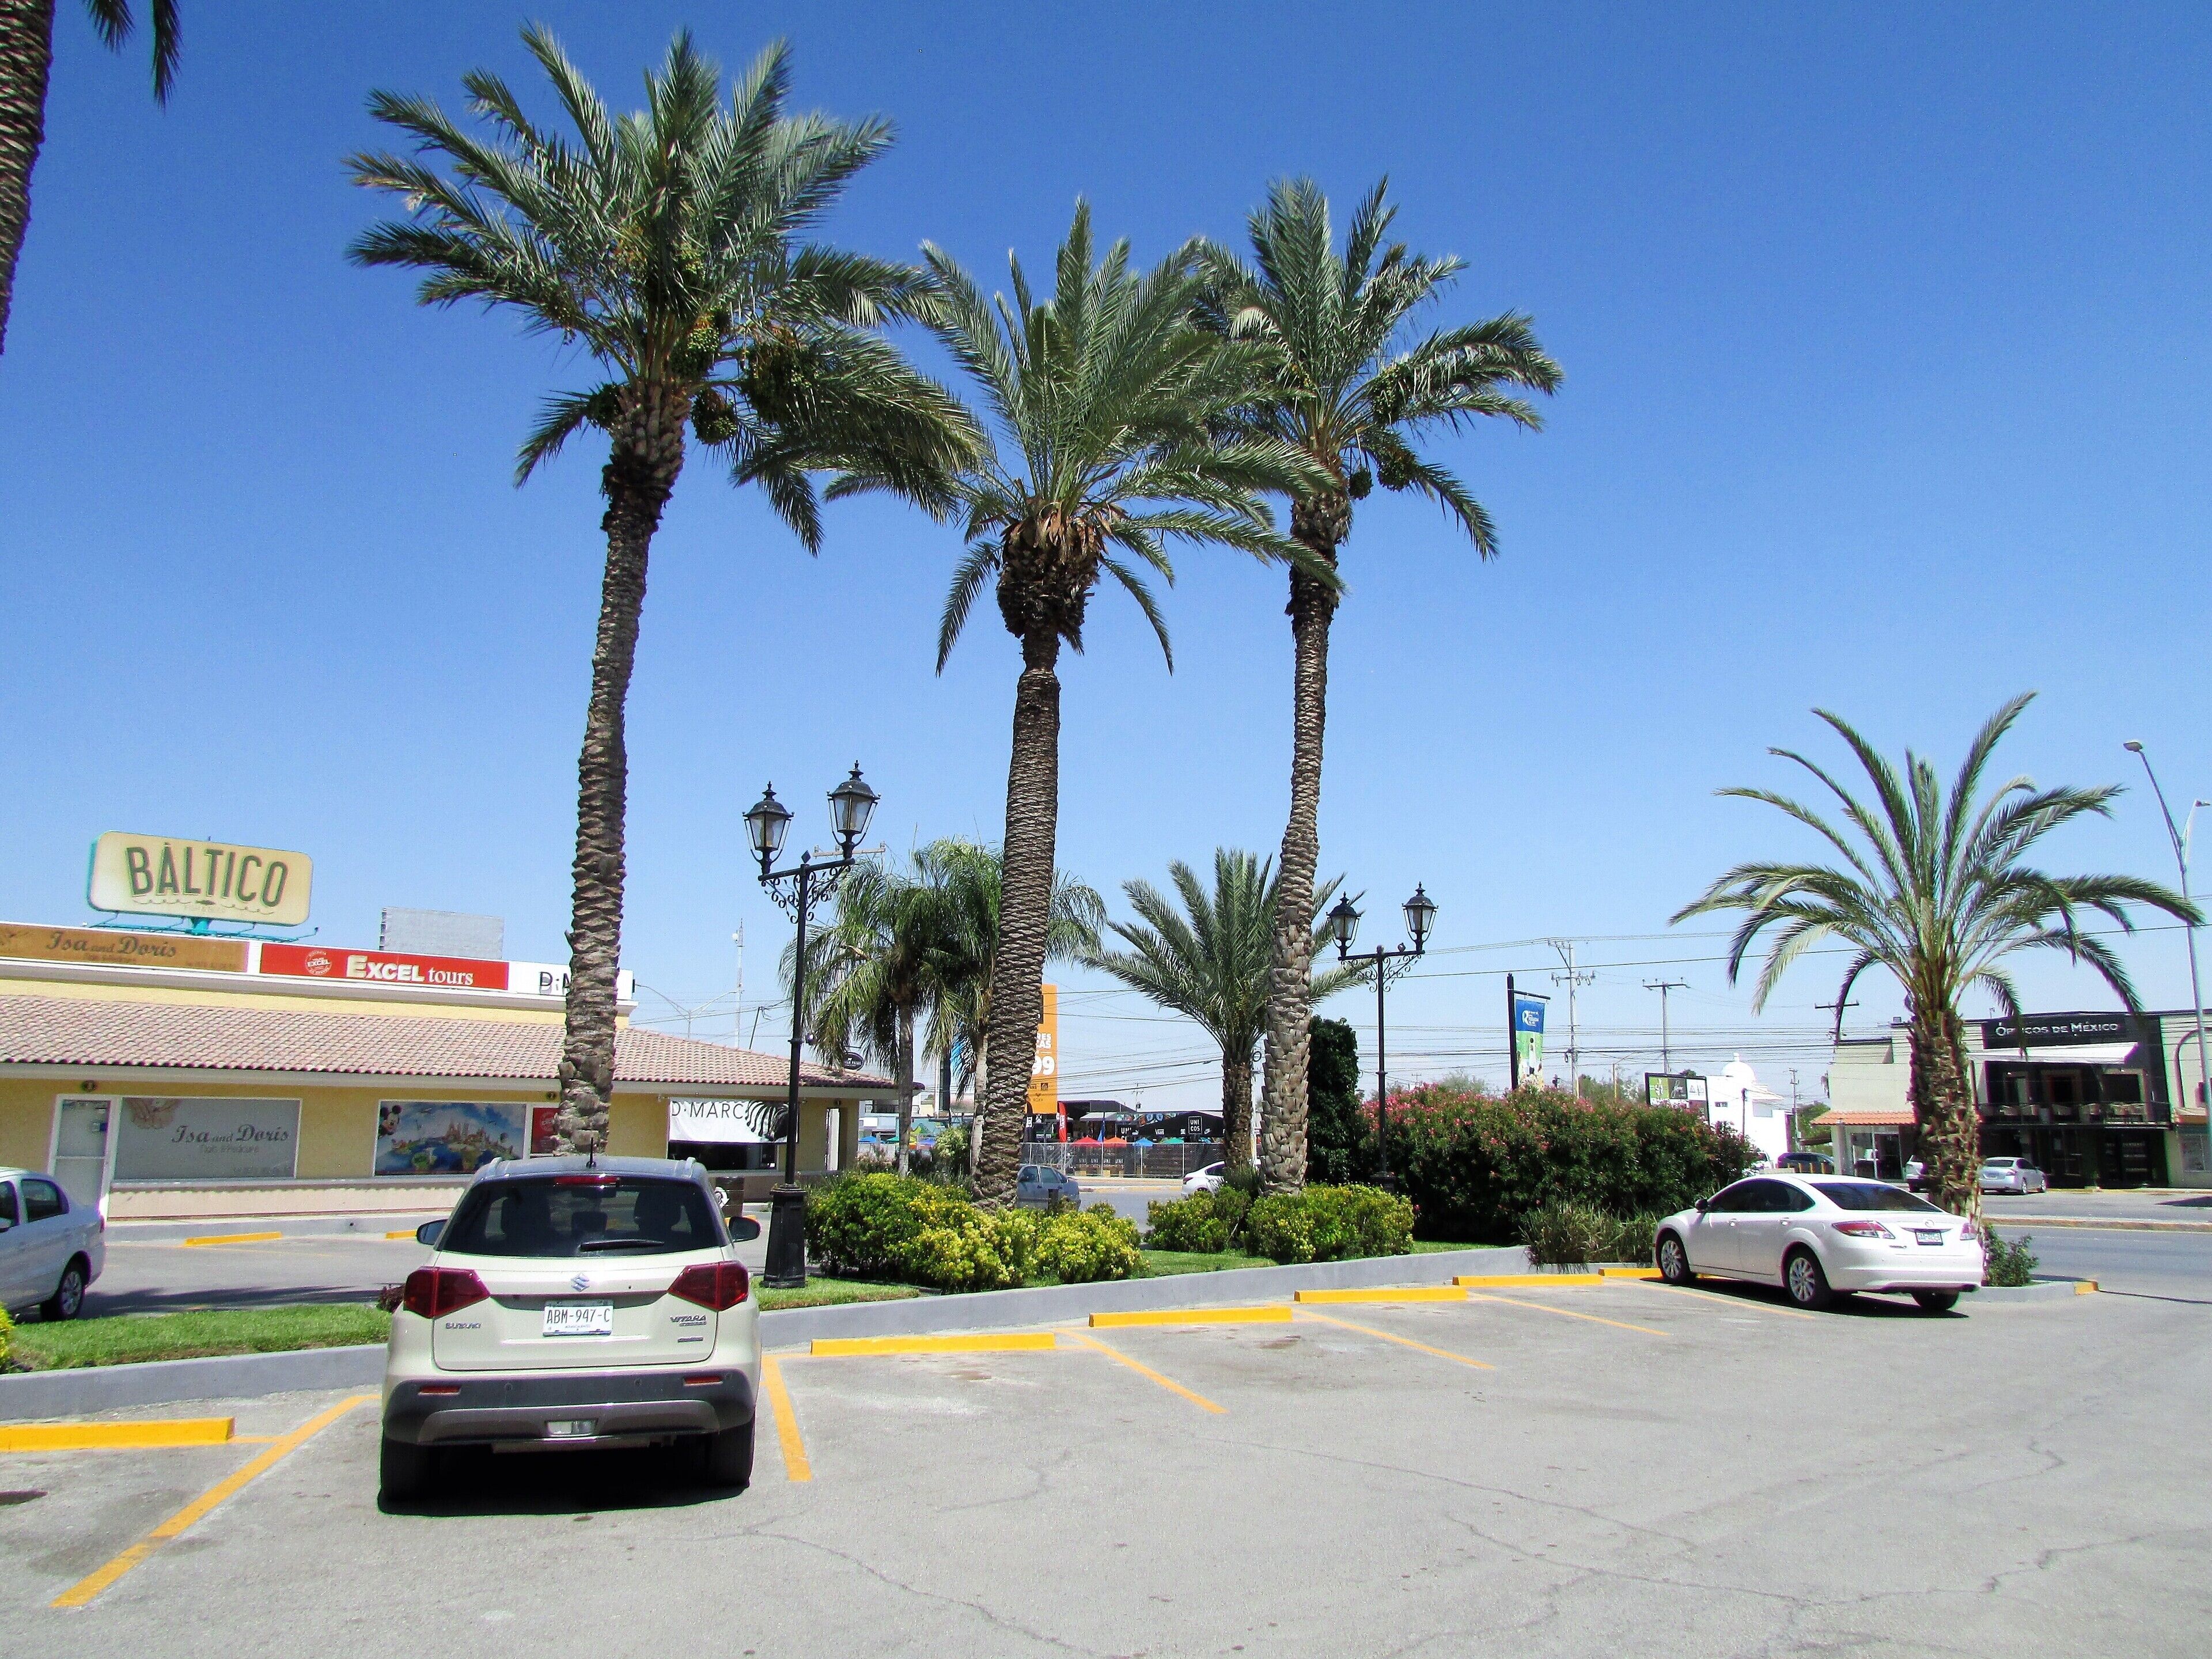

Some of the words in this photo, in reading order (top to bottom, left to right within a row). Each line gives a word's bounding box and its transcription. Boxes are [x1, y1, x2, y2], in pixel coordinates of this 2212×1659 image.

[46, 931, 87, 952] Isa
[90, 942, 115, 953] and
[117, 935, 176, 958] Doris
[306, 959, 331, 967] EXCEL
[428, 967, 474, 986] tours
[172, 1124, 210, 1143] Isa
[212, 1132, 233, 1143] and
[236, 1123, 289, 1142] Doris
[546, 1308, 611, 1324] ABM-947-C
[669, 1315, 706, 1323] VITARA
